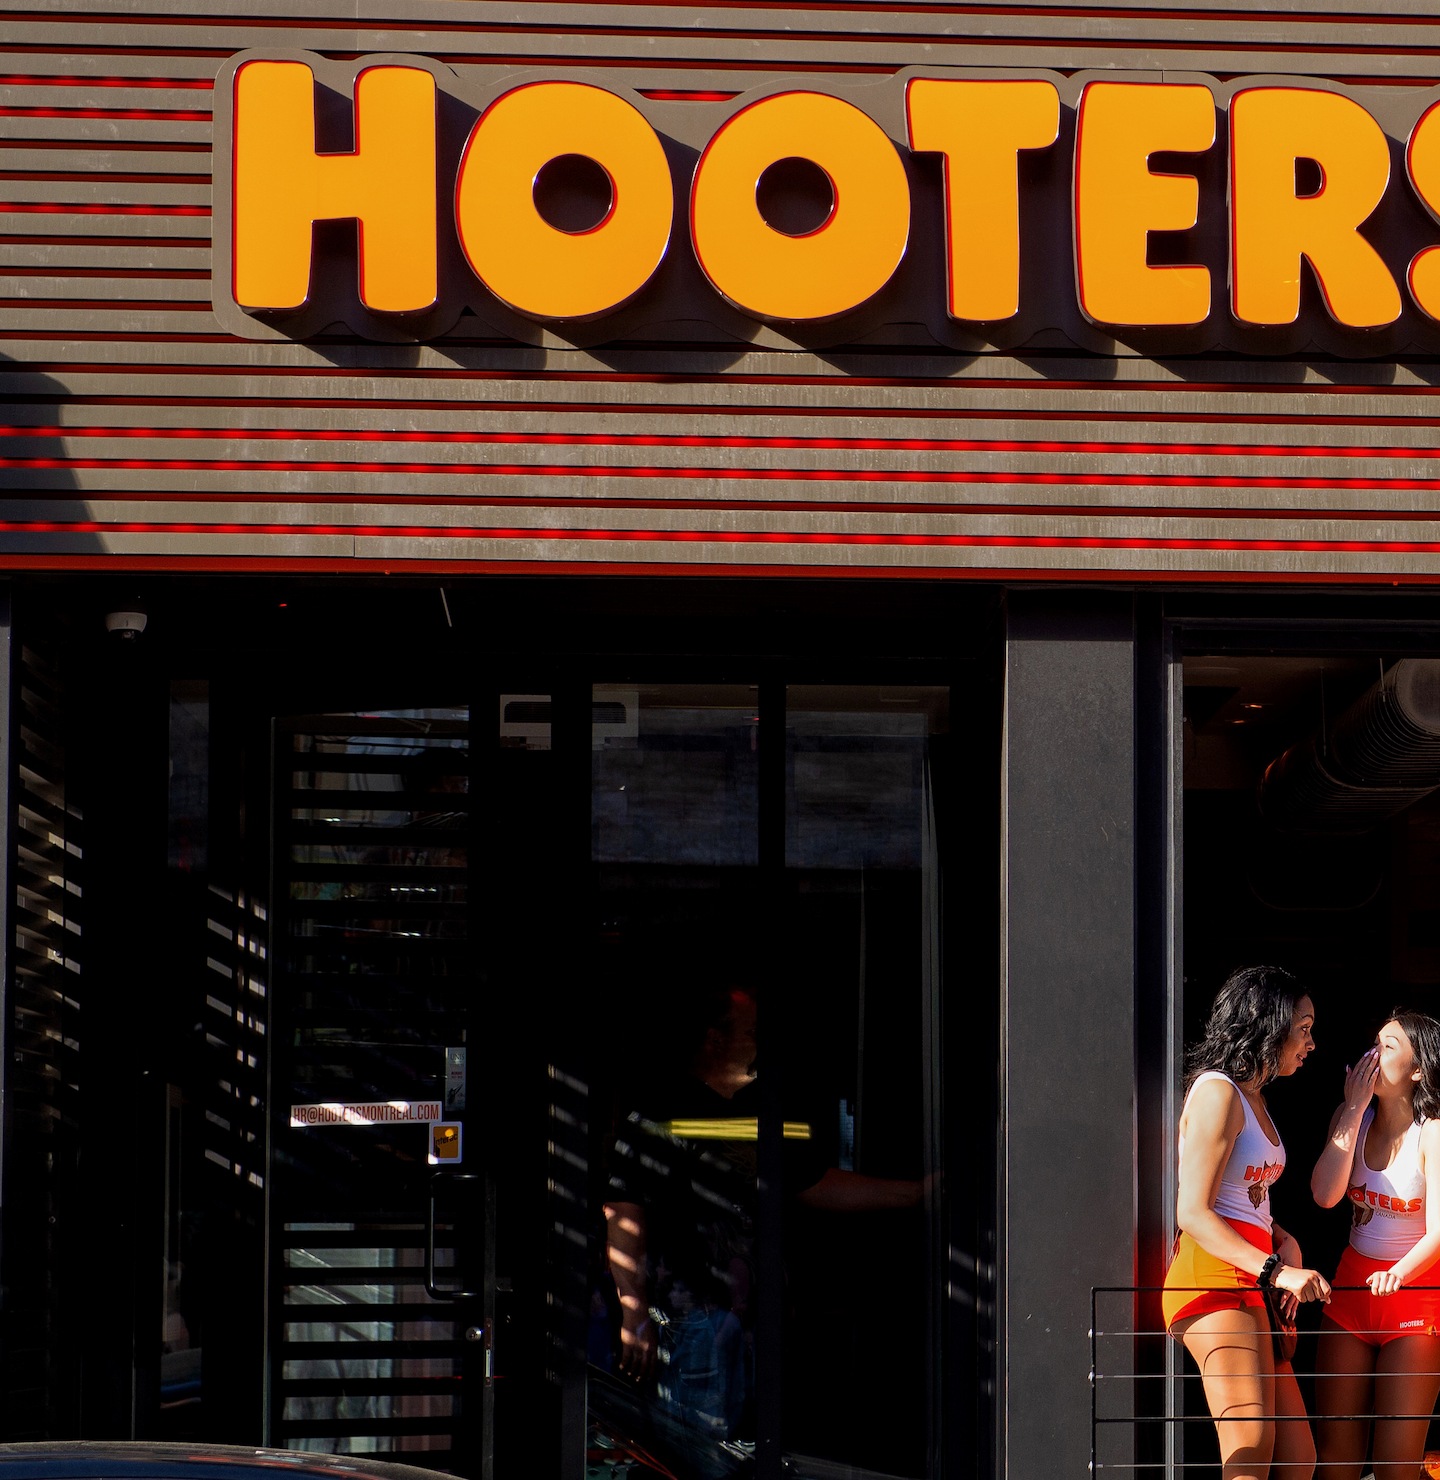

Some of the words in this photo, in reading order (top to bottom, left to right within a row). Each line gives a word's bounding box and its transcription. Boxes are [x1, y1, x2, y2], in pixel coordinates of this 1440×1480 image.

[293, 1103, 440, 1123] HR@HOOTERSMONTREAL.COM
[434, 1133, 458, 1147] Interac
[1399, 1318, 1425, 1329] HOOTERS
